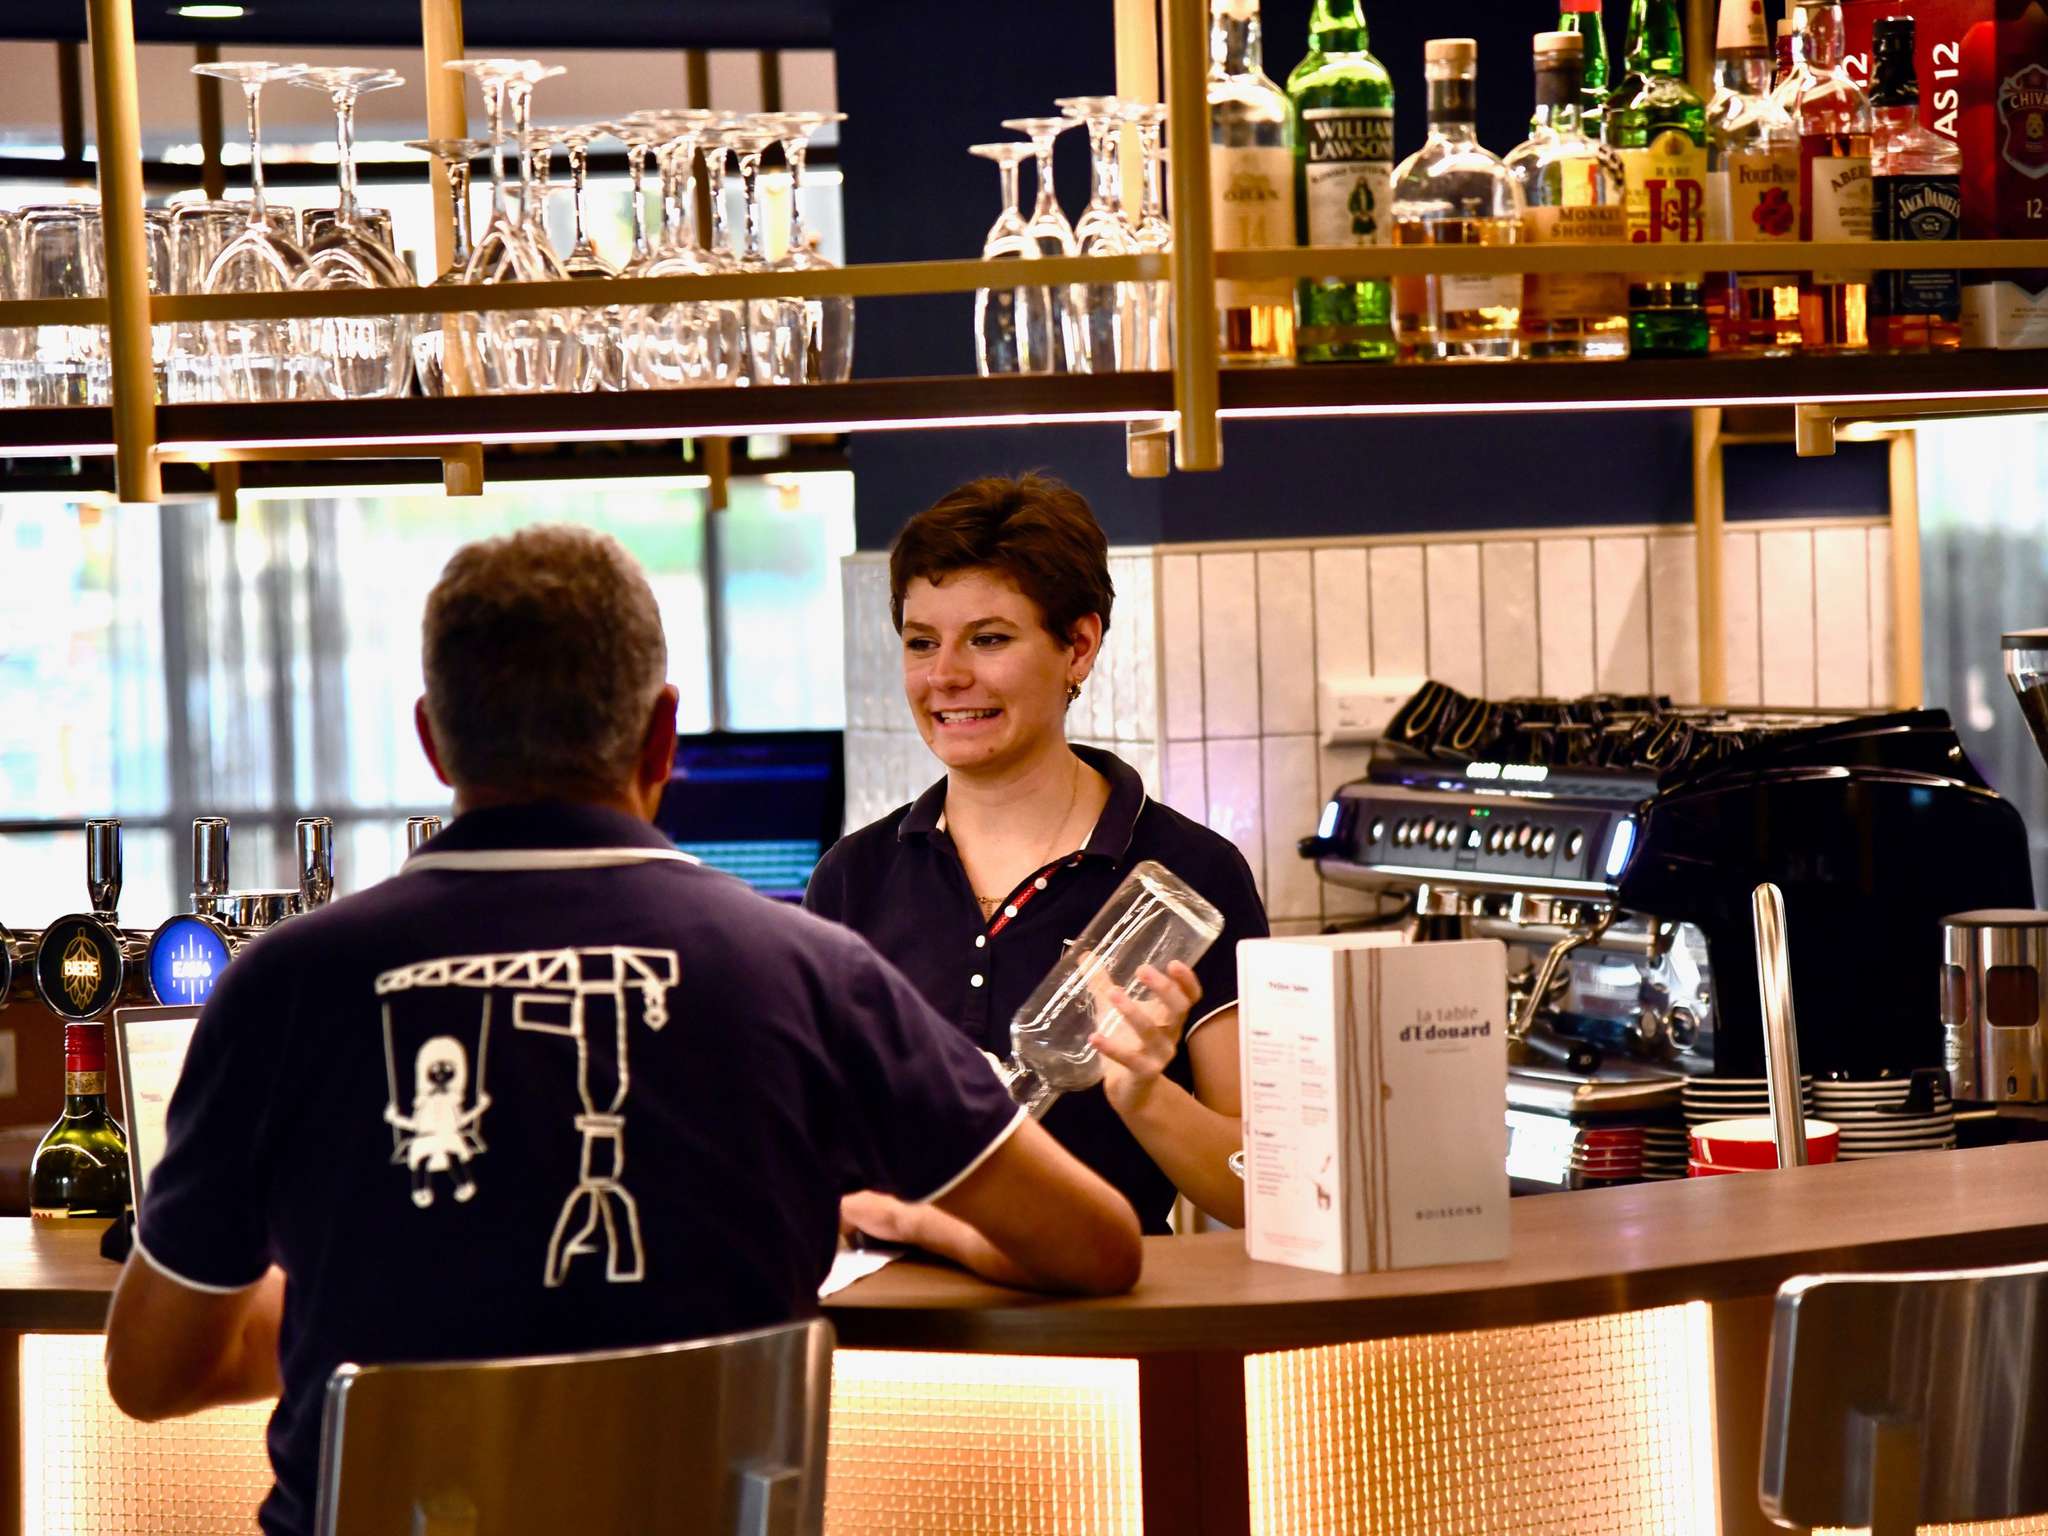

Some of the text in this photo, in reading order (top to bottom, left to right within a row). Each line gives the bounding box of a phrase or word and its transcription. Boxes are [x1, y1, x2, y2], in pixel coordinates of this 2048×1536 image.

[1933, 41, 1959, 80] 12
[1897, 194, 1926, 220] JACK
[2025, 198, 2043, 219] 12
